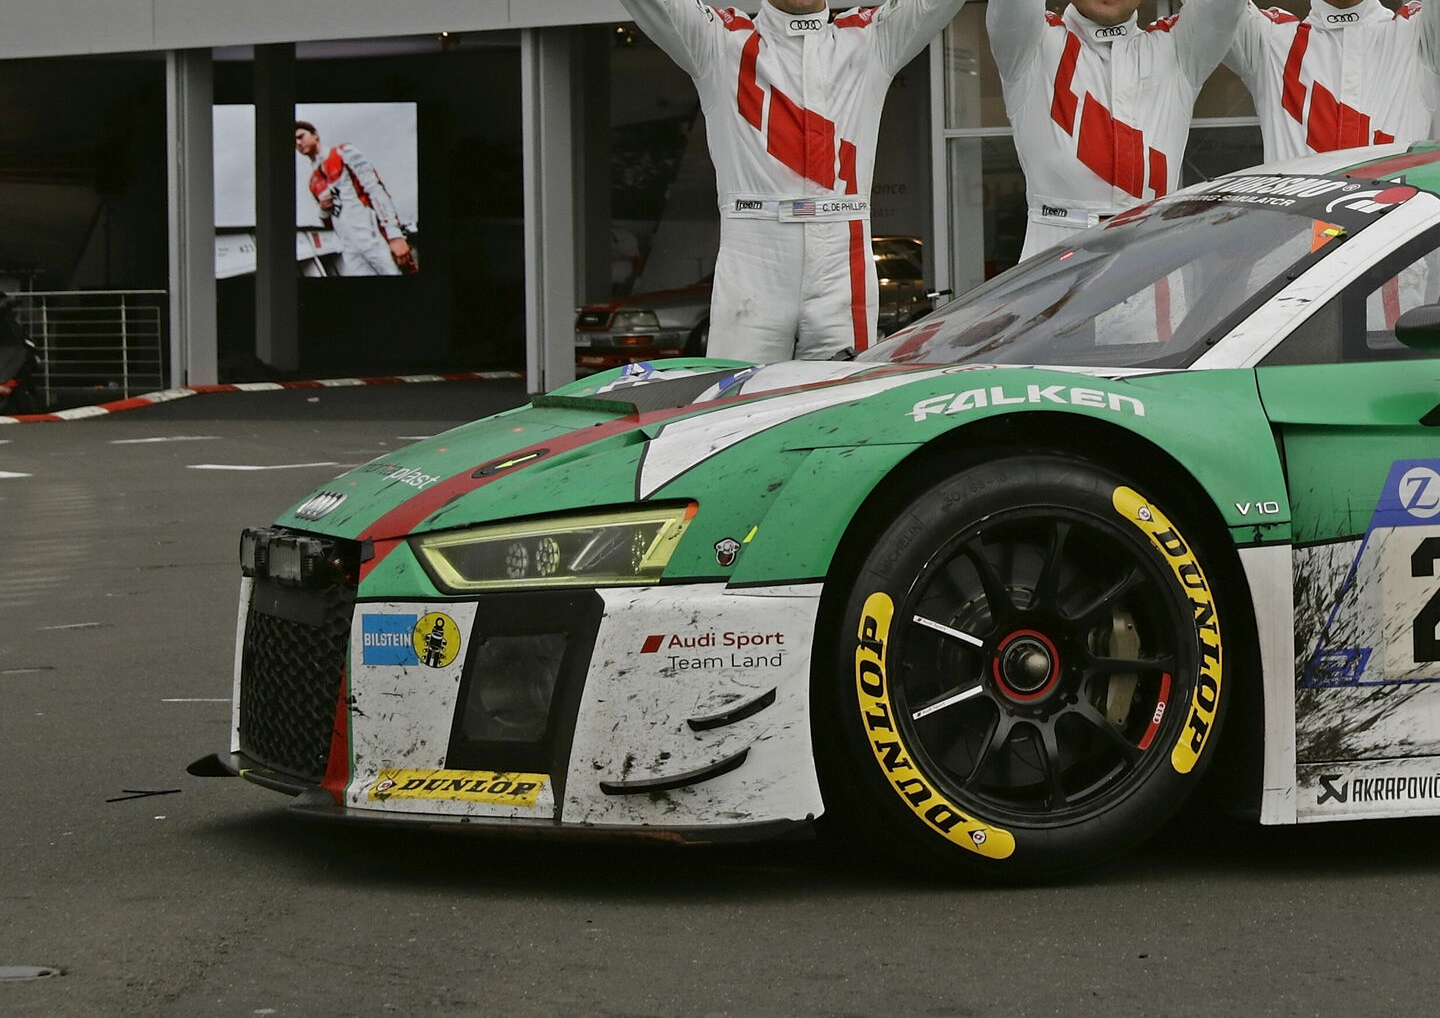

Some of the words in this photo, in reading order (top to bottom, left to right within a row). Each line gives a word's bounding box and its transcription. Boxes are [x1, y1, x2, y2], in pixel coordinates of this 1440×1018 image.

[831, 203, 841, 212] DE
[905, 384, 1146, 422] FALKEN
[364, 633, 412, 648] BILSTEIN
[668, 633, 716, 649] Audi
[723, 632, 784, 650] Sport
[1152, 525, 1221, 757] DUNLOP
[668, 655, 723, 670] Team
[731, 653, 782, 668] Land
[856, 615, 968, 835] DUNLOP
[398, 778, 542, 797] DUNLOP
